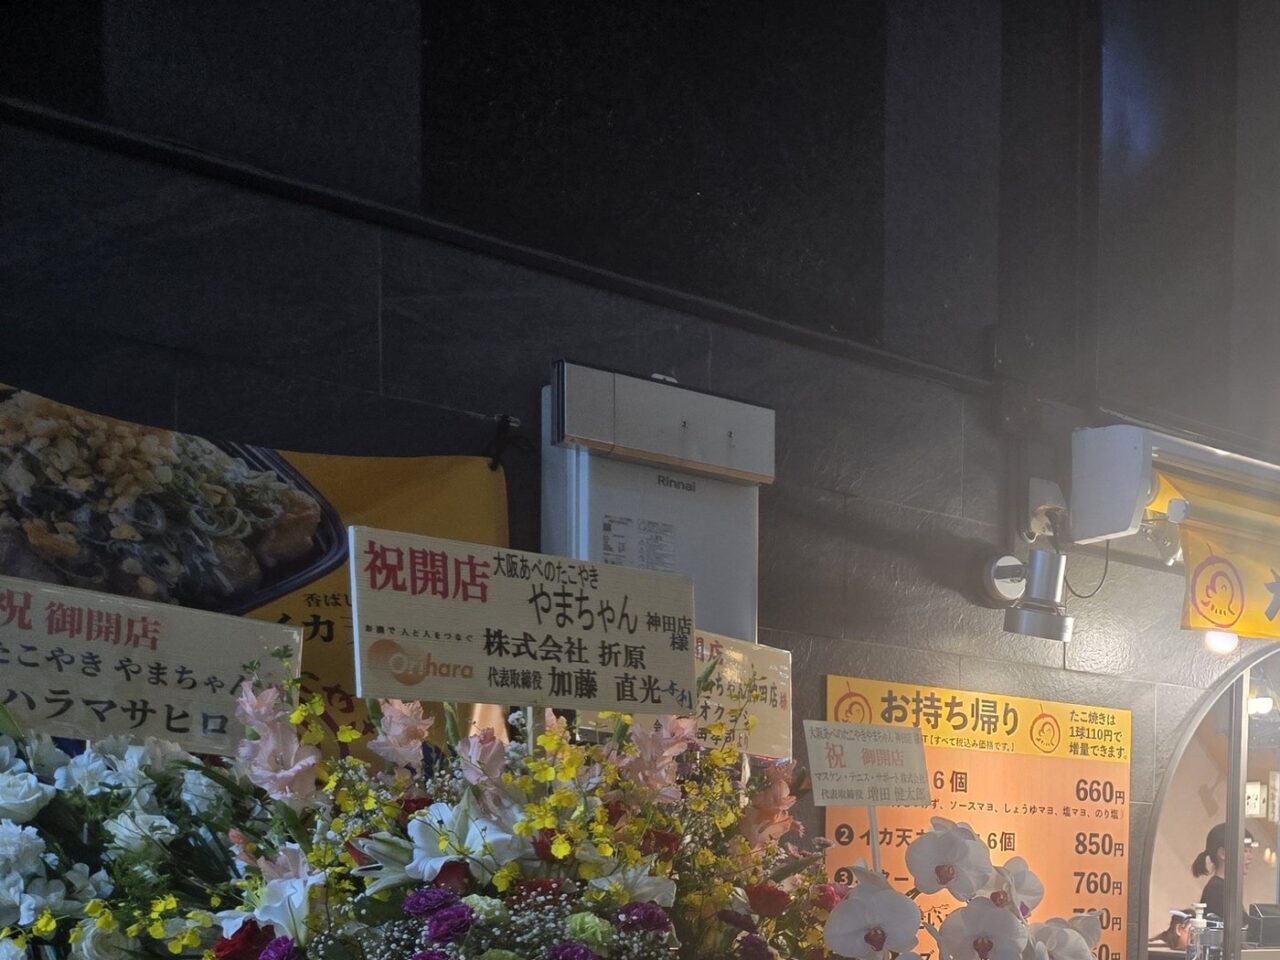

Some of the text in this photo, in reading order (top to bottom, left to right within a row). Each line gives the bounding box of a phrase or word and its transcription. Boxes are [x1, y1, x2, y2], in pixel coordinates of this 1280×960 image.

[657, 475, 696, 492] Rinnai
[364, 540, 491, 603] 祝開店
[493, 551, 600, 590] 大阪あべのたこやき
[529, 584, 692, 636] やまちゃん 神田店
[45, 602, 161, 650] 御開店
[483, 628, 647, 670] 株式会社 折原
[488, 666, 543, 690] 代表取締役
[549, 666, 598, 699] 加藤
[614, 673, 662, 704] 直光
[880, 690, 1019, 736] お持ち帰り
[1070, 710, 1116, 726] たこ焼きは
[1070, 726, 1123, 742] 1球110円で
[824, 741, 847, 769] 祝
[1069, 741, 1128, 760] 増量できます。
[1075, 779, 1125, 805] 660円
[1075, 832, 1124, 856] 850円
[1073, 871, 1123, 895] 760円
